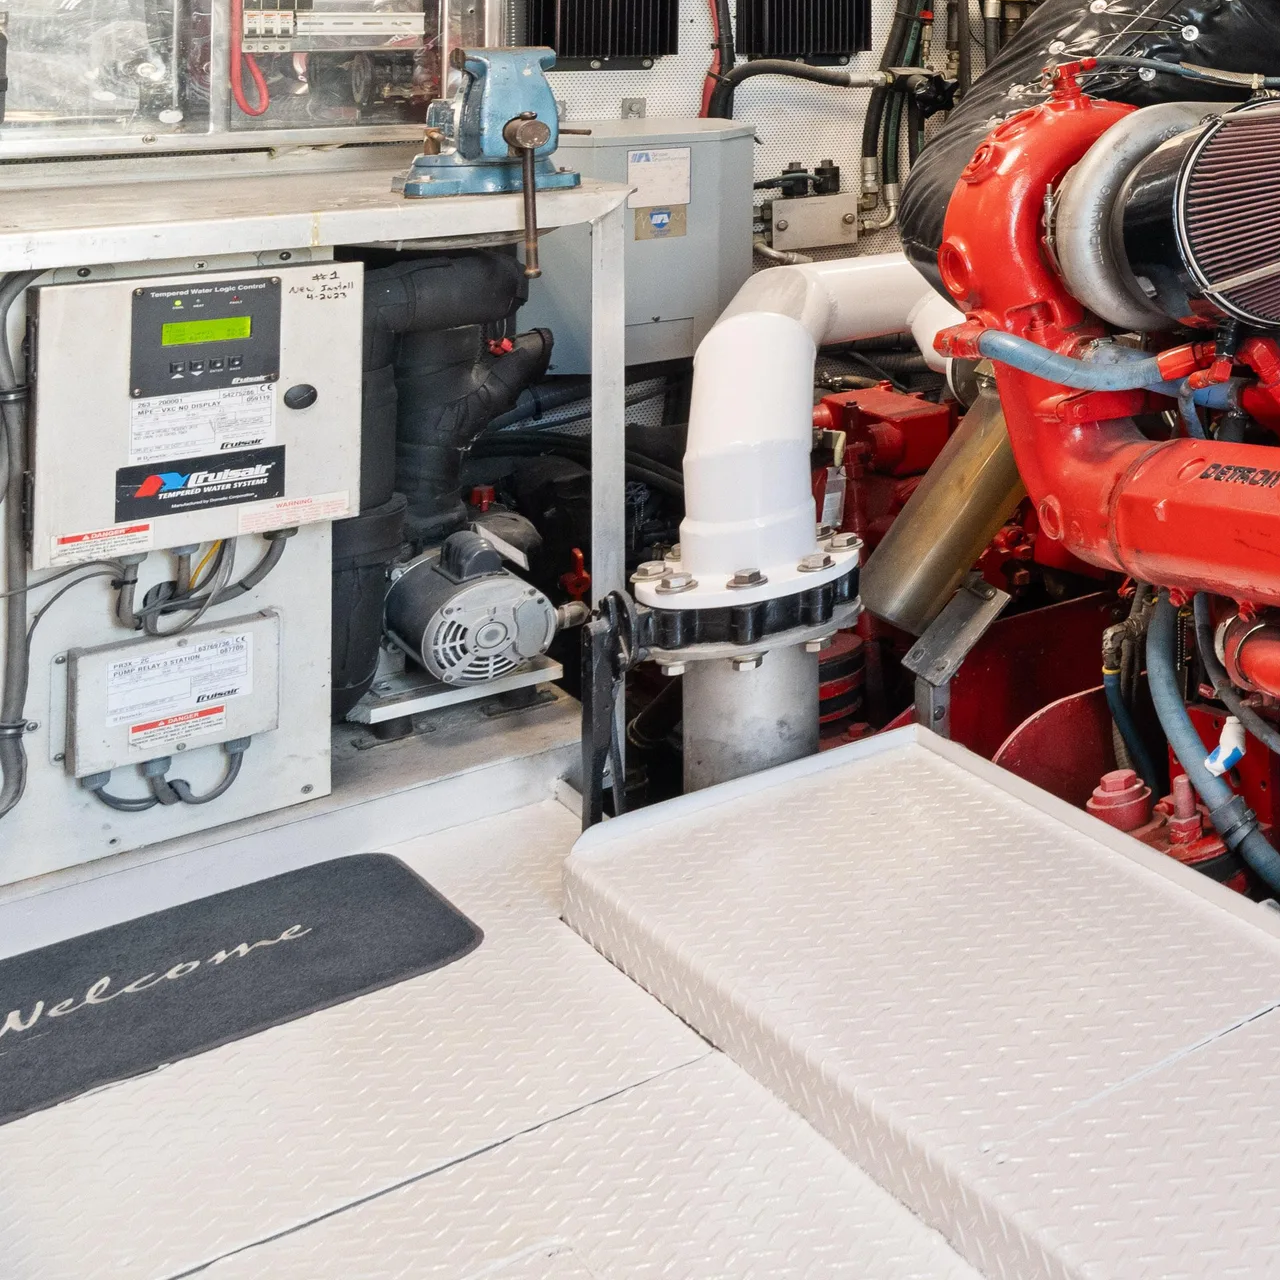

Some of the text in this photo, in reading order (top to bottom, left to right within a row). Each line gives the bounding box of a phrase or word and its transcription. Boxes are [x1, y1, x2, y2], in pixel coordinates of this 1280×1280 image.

[150, 283, 266, 298] Tempered Water Logic Control
[190, 400, 222, 410] DISPLAY
[220, 438, 265, 450] Cruisair
[188, 464, 272, 488] Cruisair
[158, 478, 268, 500] TEMPERED WATER SYSTEMS
[171, 500, 202, 508] Manufactured
[276, 498, 312, 509] WARNING
[90, 529, 126, 538] DANGER
[114, 668, 136, 678] PUMP
[138, 663, 160, 672] RELAY
[170, 654, 200, 666] STATION
[196, 688, 239, 703] Cruisair
[168, 712, 200, 724] DANGER
